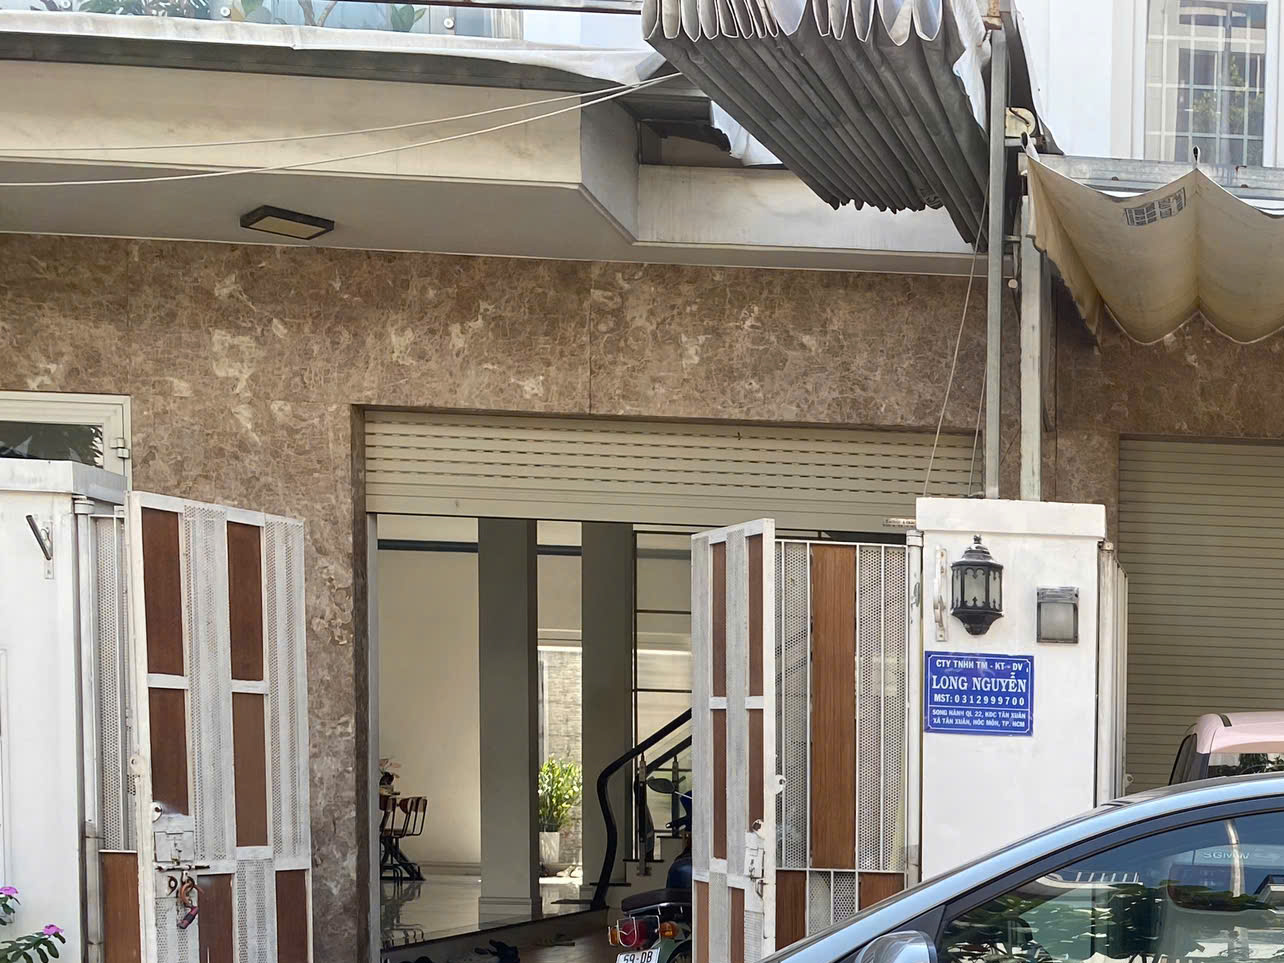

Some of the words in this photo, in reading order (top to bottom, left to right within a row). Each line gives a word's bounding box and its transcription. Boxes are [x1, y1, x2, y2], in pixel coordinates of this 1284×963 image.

[936, 659, 951, 668] CTY
[953, 660, 974, 669] TNHH
[976, 661, 988, 669] TM
[995, 662, 1005, 670] KT
[1012, 663, 1023, 671] DV
[931, 675, 968, 690] LONG
[972, 672, 1027, 693] NGUYỄN
[933, 694, 953, 703] MST:
